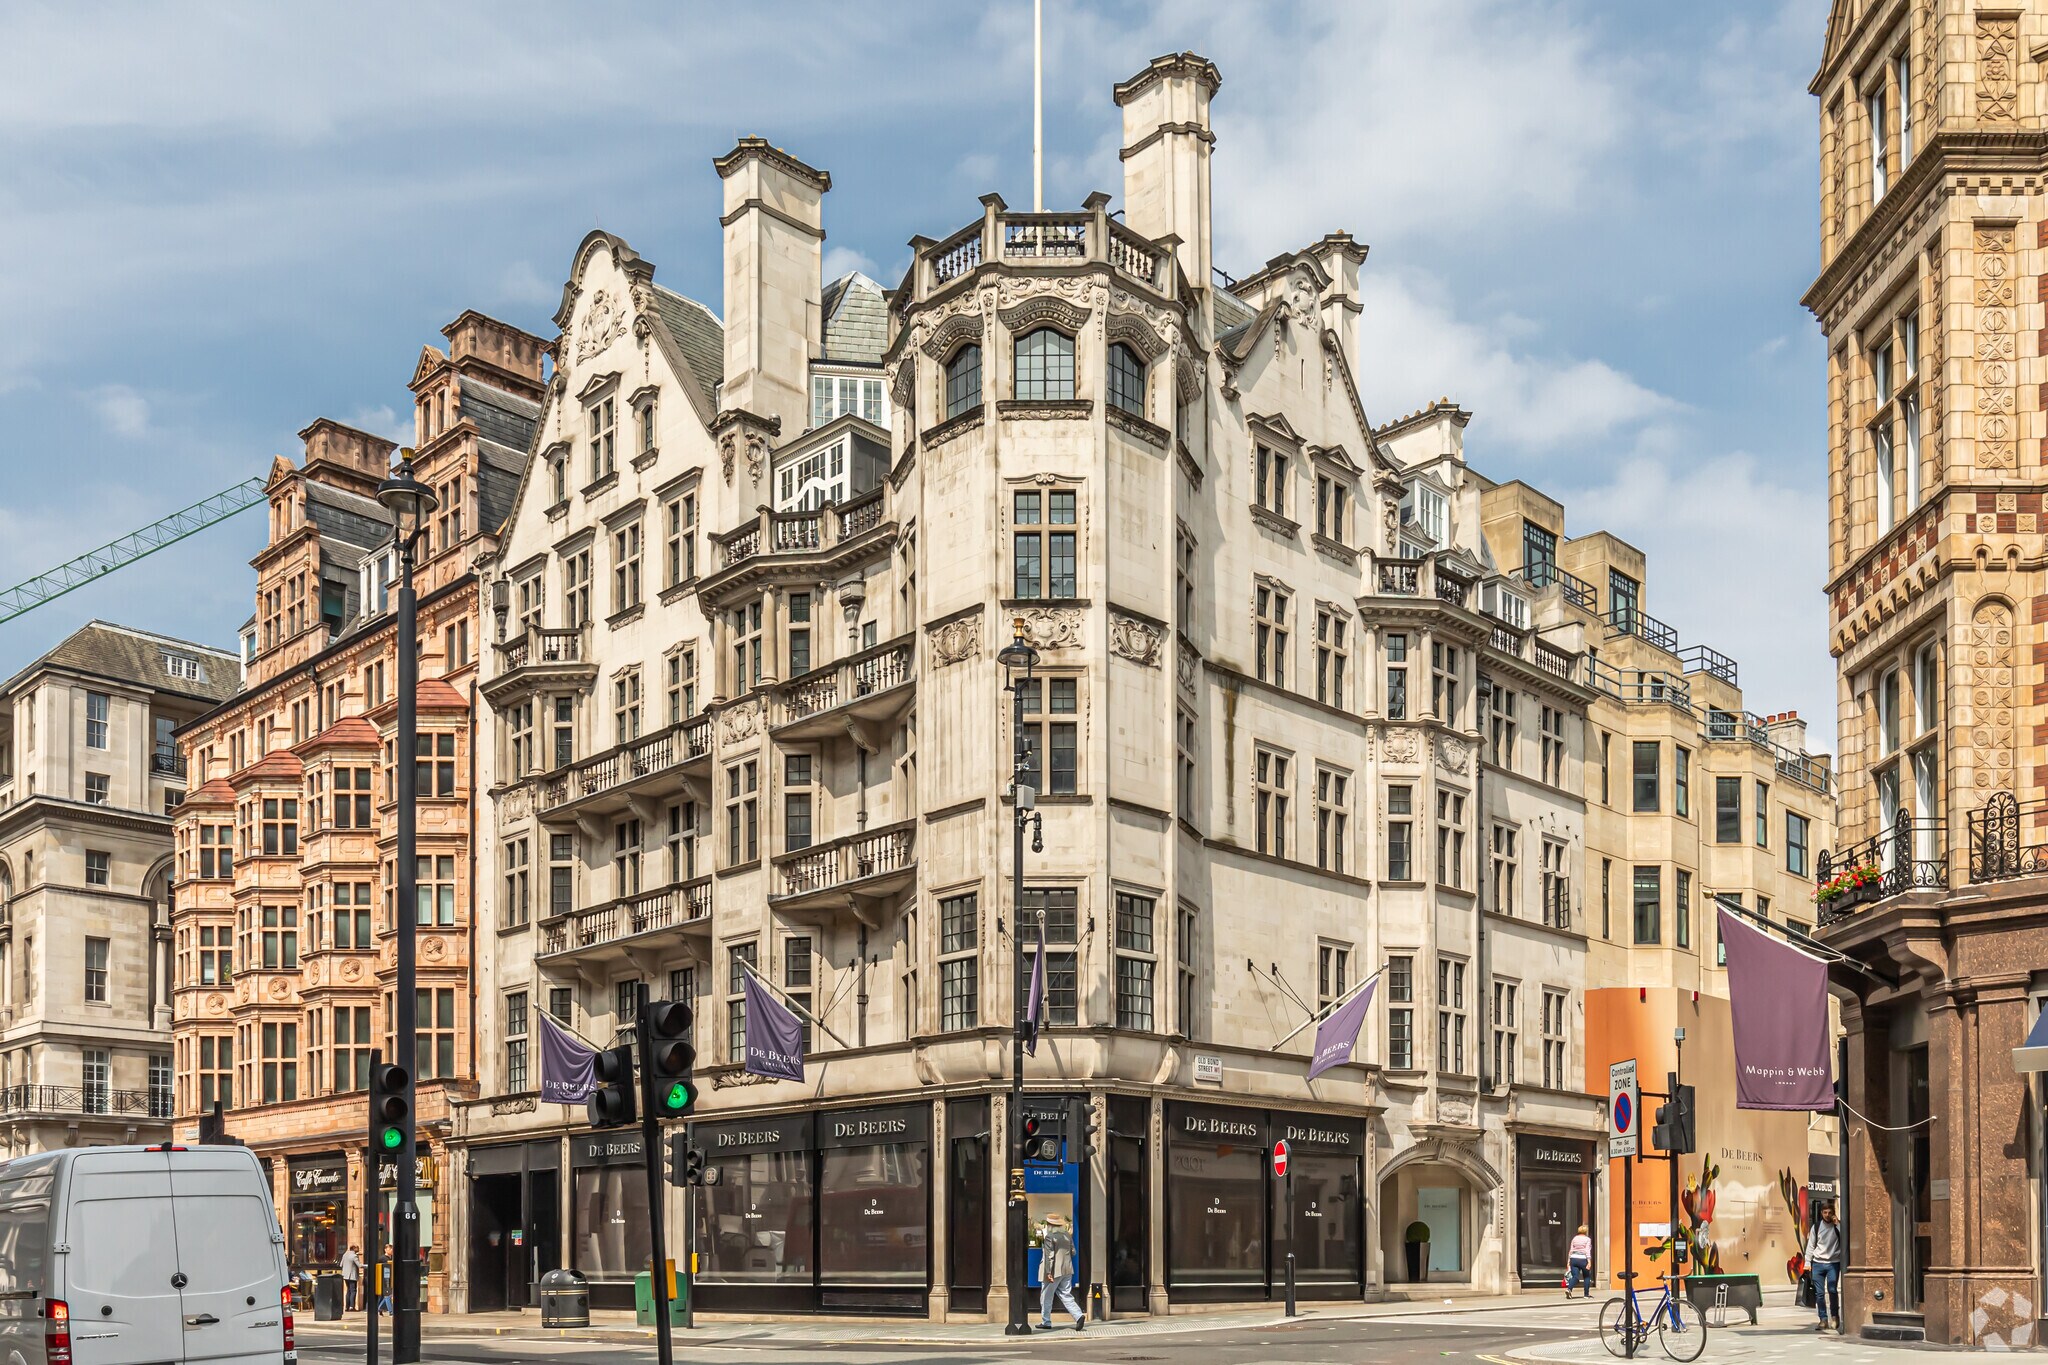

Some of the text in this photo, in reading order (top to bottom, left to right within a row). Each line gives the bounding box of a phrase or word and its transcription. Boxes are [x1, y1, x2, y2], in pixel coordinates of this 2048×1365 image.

[750, 1047, 801, 1065] DE BEERS
[1322, 1041, 1350, 1057] BEERS
[1198, 1065, 1213, 1073] STREET
[1207, 1058, 1219, 1066] BOND
[1611, 1064, 1635, 1077] Controlled
[1745, 1065, 1825, 1078] Mappin & Webb
[545, 1080, 595, 1091] DE BEERS
[1614, 1077, 1631, 1090] ZONE
[834, 1119, 906, 1137] DE BEERS
[1185, 1116, 1257, 1136] DE BEERS
[718, 1130, 780, 1147] DE BEERS
[1286, 1125, 1350, 1144] DE BEERS
[589, 1142, 641, 1157] DE BEERS
[1535, 1148, 1582, 1163] DE BEERS
[1721, 1147, 1763, 1162] DE BEERS
[313, 1168, 341, 1187] Concerto
[1814, 1182, 1833, 1192] DUBUIS
